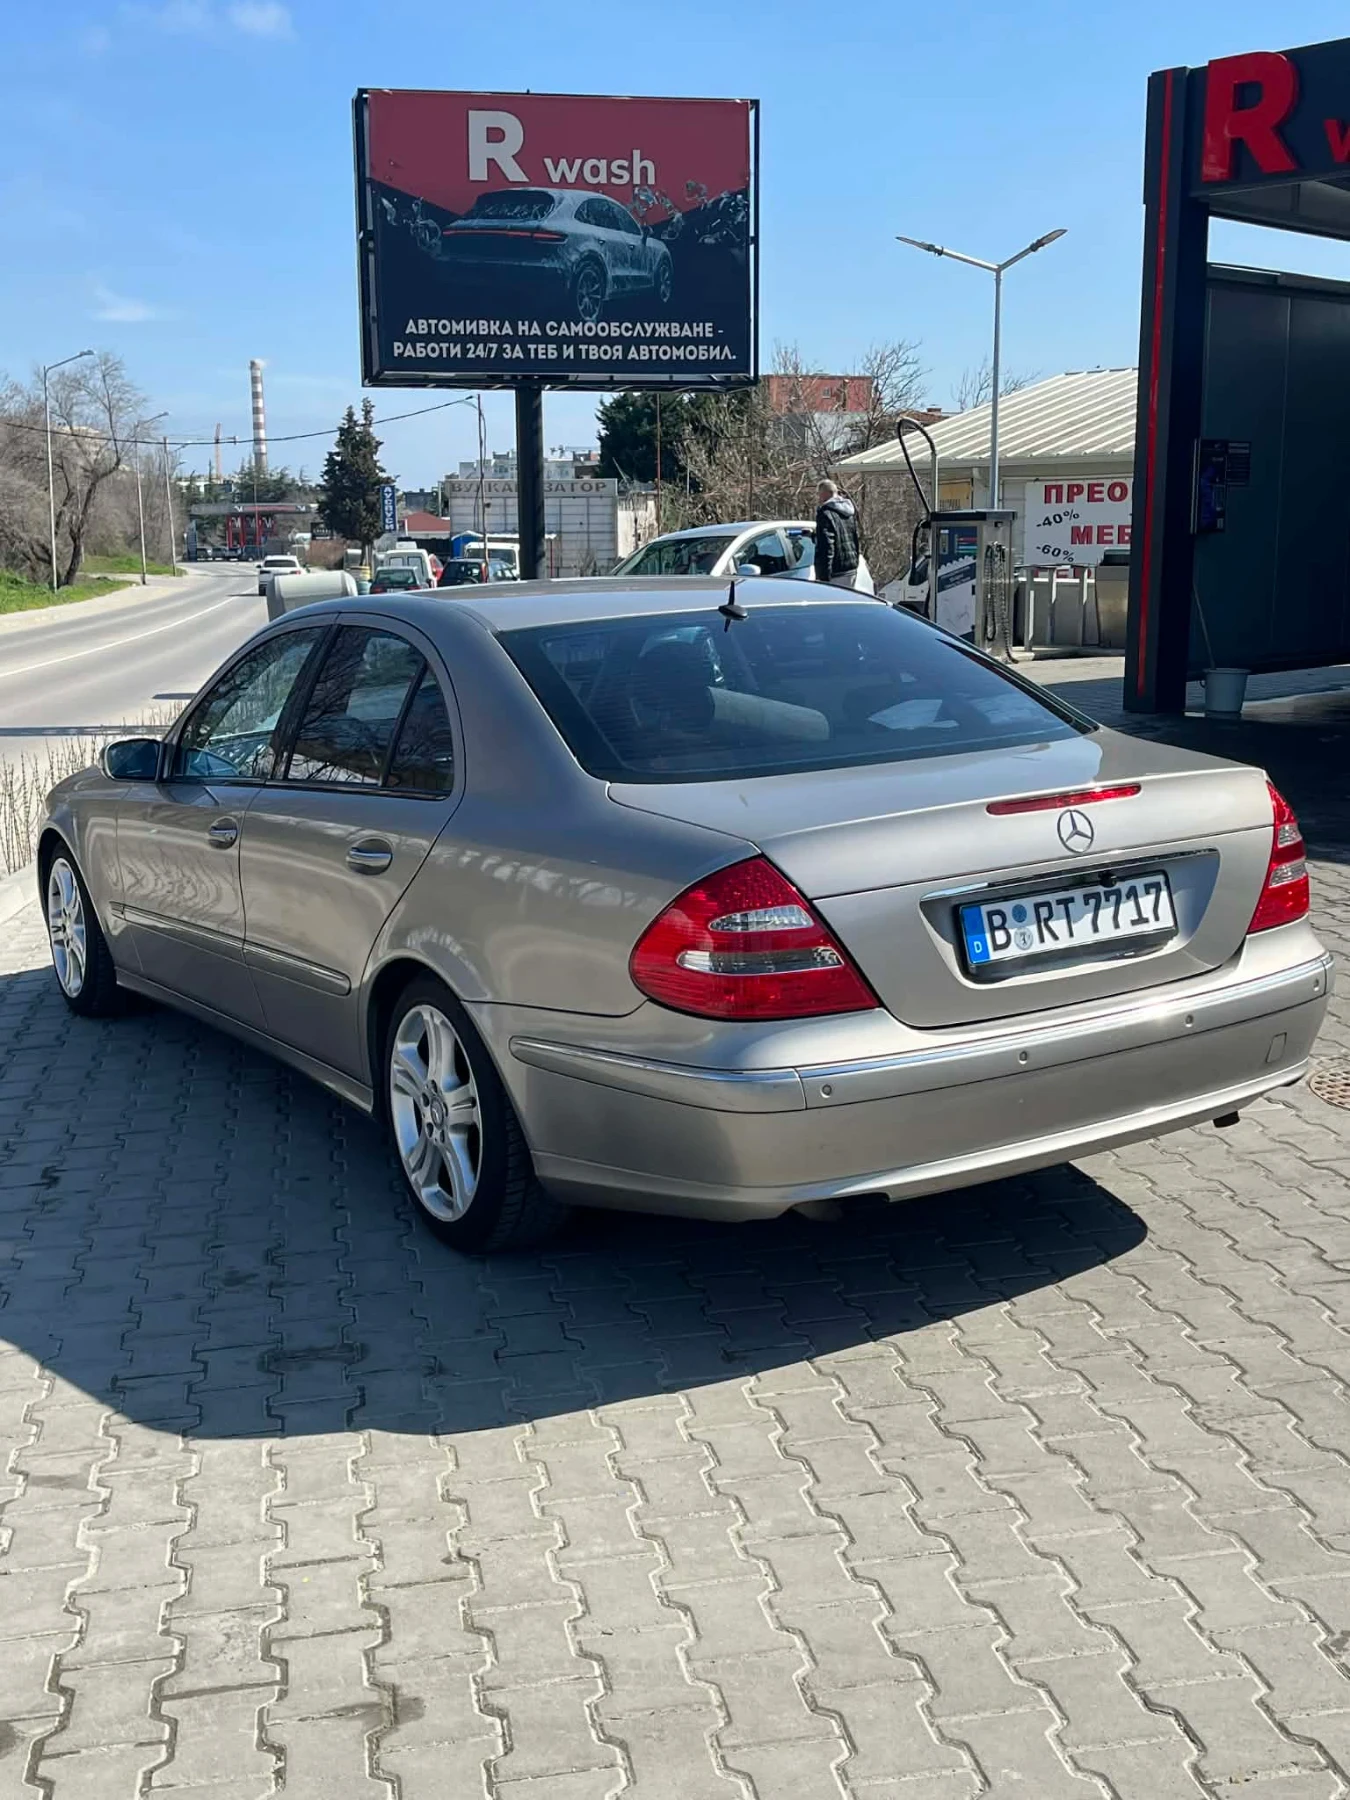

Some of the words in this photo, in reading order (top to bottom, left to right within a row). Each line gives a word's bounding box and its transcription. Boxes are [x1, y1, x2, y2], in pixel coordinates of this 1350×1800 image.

[1202, 51, 1299, 183] R
[468, 110, 530, 182] R
[543, 149, 656, 185] wash
[405, 319, 514, 335] АВТОМИВКА
[518, 321, 542, 336] НА
[545, 321, 714, 338] САМООБСЛУЖВАНЕ
[393, 341, 462, 358] РАБОТИ
[466, 343, 498, 359] 24/7
[502, 344, 524, 359] ЗА
[527, 344, 558, 360] ТЕБ
[562, 344, 574, 360] И
[578, 344, 623, 360] ТВОЯ
[627, 345, 737, 361] АВТОМОБИЛ.
[1044, 481, 1129, 504] ПРЕО
[1036, 508, 1080, 528] -40%
[1035, 544, 1075, 563] -60%
[974, 941, 983, 954] D
[986, 909, 1012, 951] B
[1033, 896, 1075, 944] RT
[1083, 881, 1163, 934] 7717
